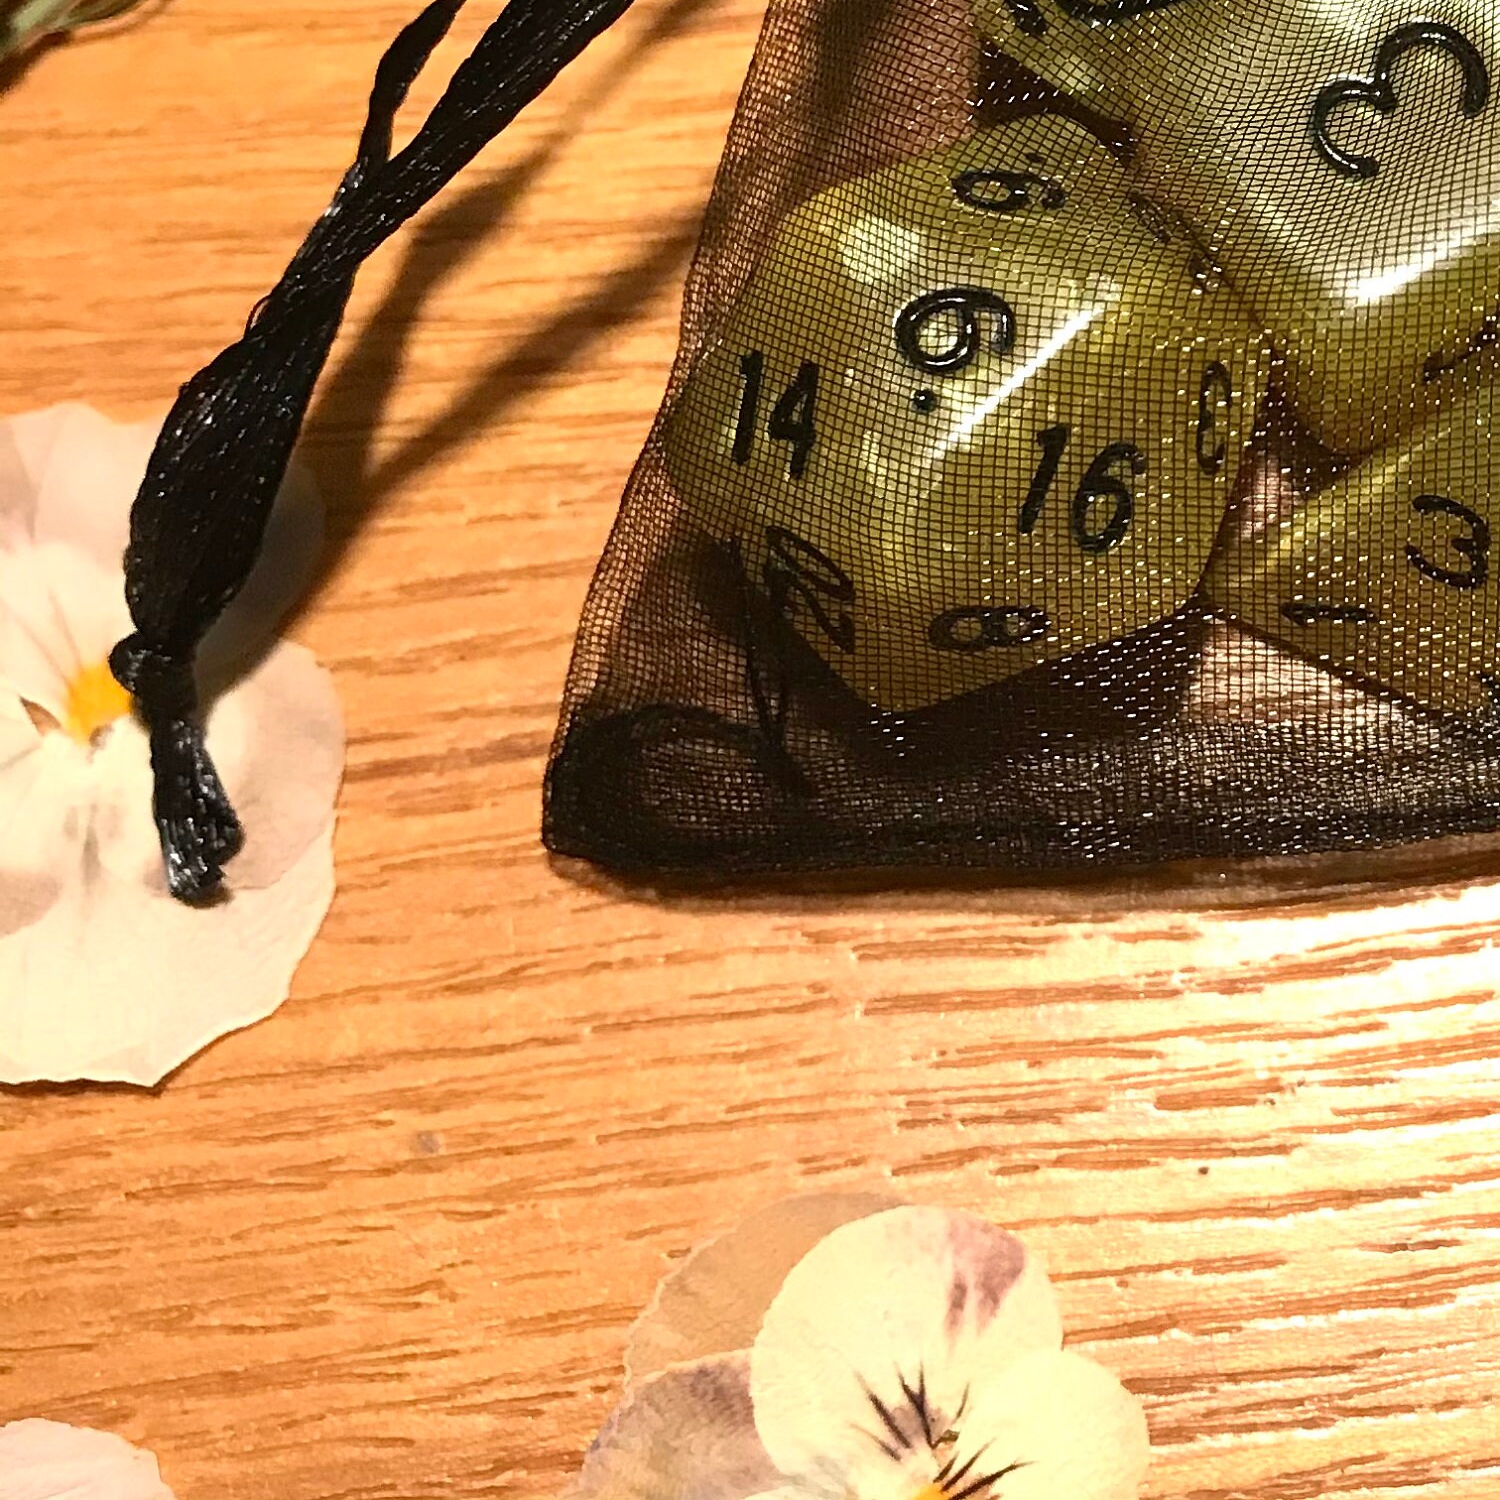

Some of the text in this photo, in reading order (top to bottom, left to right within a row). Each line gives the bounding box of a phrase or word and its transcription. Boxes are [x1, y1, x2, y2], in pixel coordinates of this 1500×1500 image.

[1310, 20, 1490, 180] 3
[732, 350, 820, 480] 14
[1016, 424, 1145, 552] 16
[1404, 493, 1491, 590] 3
